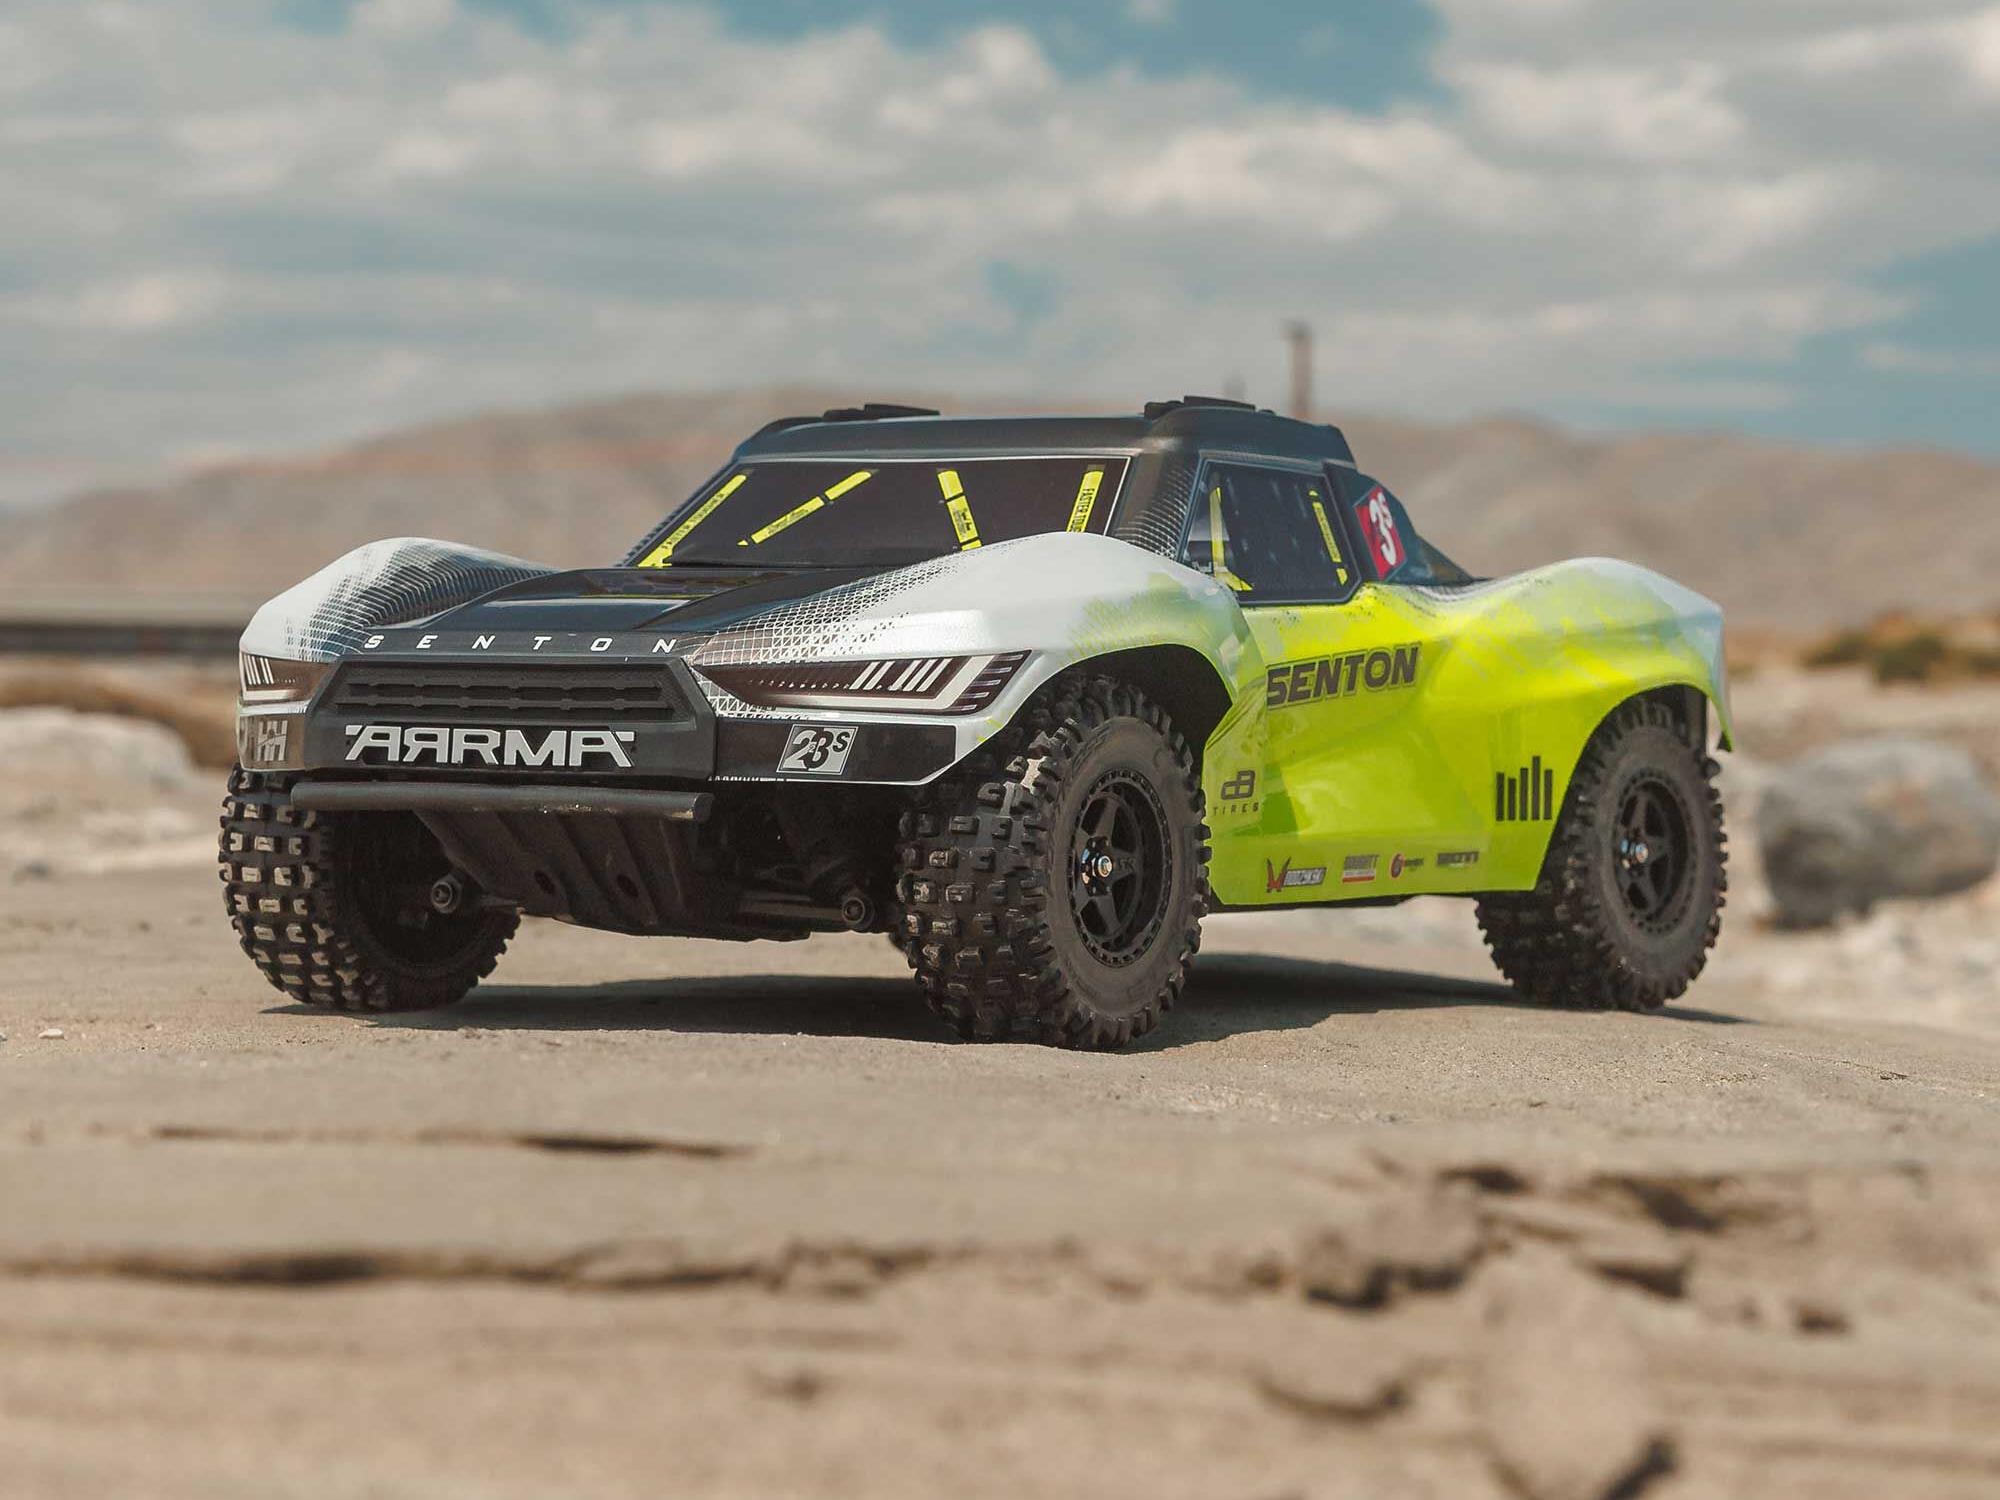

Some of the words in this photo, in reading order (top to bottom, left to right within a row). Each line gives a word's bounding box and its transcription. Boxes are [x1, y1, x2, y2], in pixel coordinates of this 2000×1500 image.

[363, 634, 678, 654] SENTON
[1266, 645, 1421, 709] SENTON
[345, 724, 636, 768] ARRMA
[1212, 801, 1260, 815] TIRES
